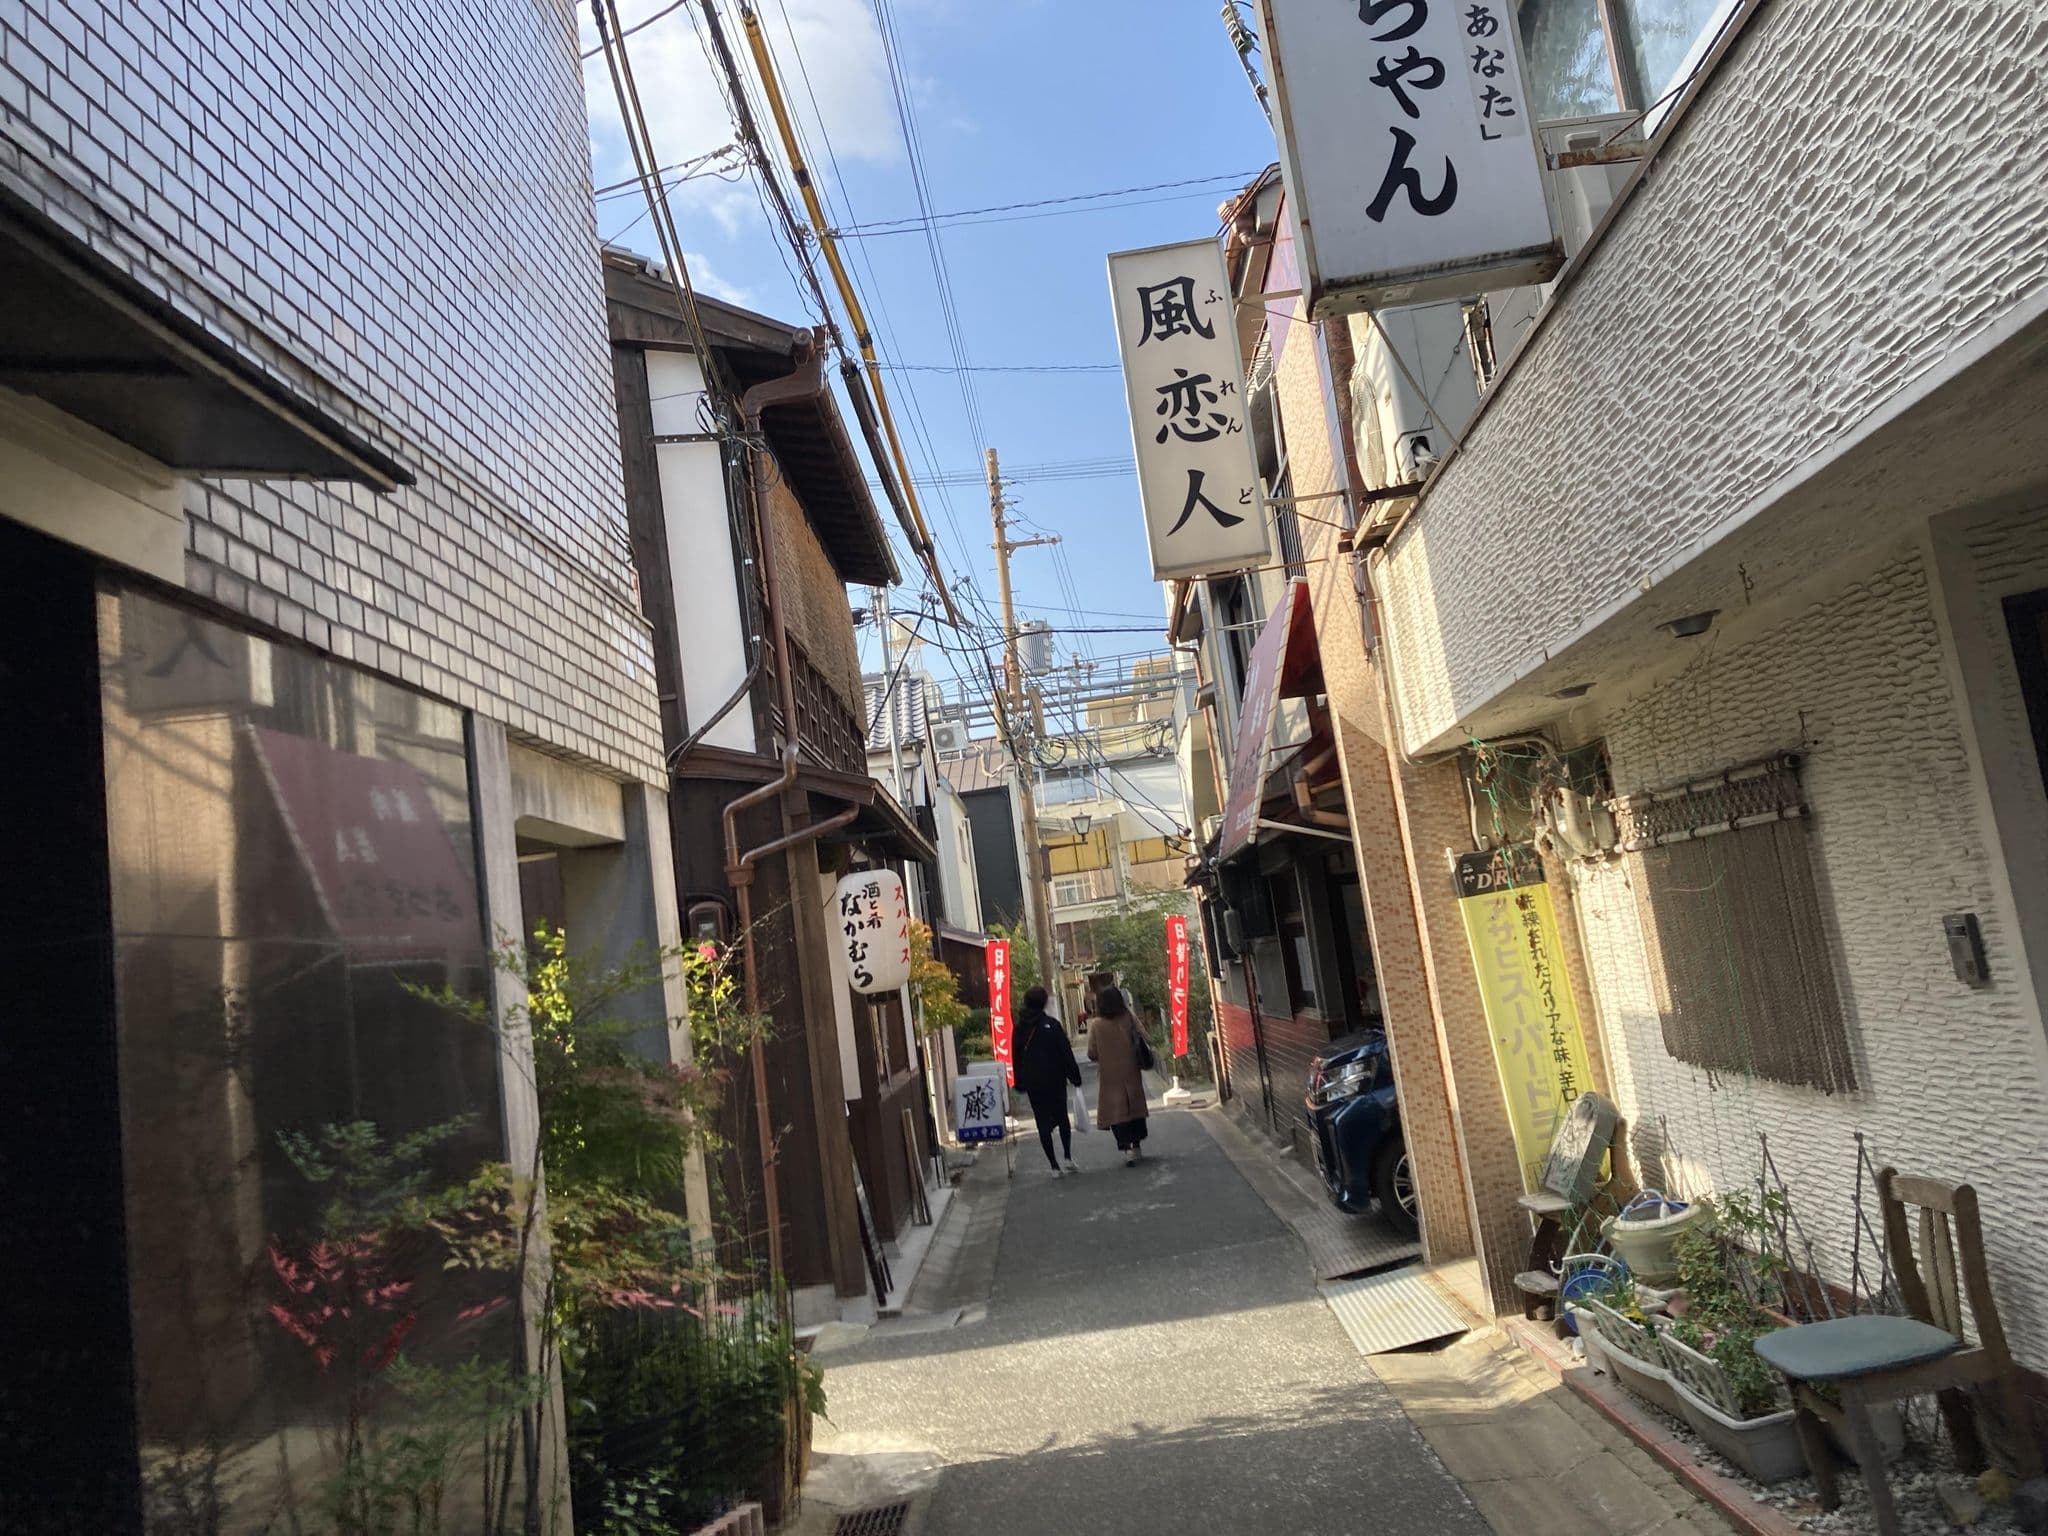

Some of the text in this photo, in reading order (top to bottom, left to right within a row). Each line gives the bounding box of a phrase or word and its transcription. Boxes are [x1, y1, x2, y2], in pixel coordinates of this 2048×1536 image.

[1137, 276, 1244, 537] 風恋人
[840, 890, 873, 988] なかむら
[1484, 896, 1554, 1160] アサヒスーパードラ
